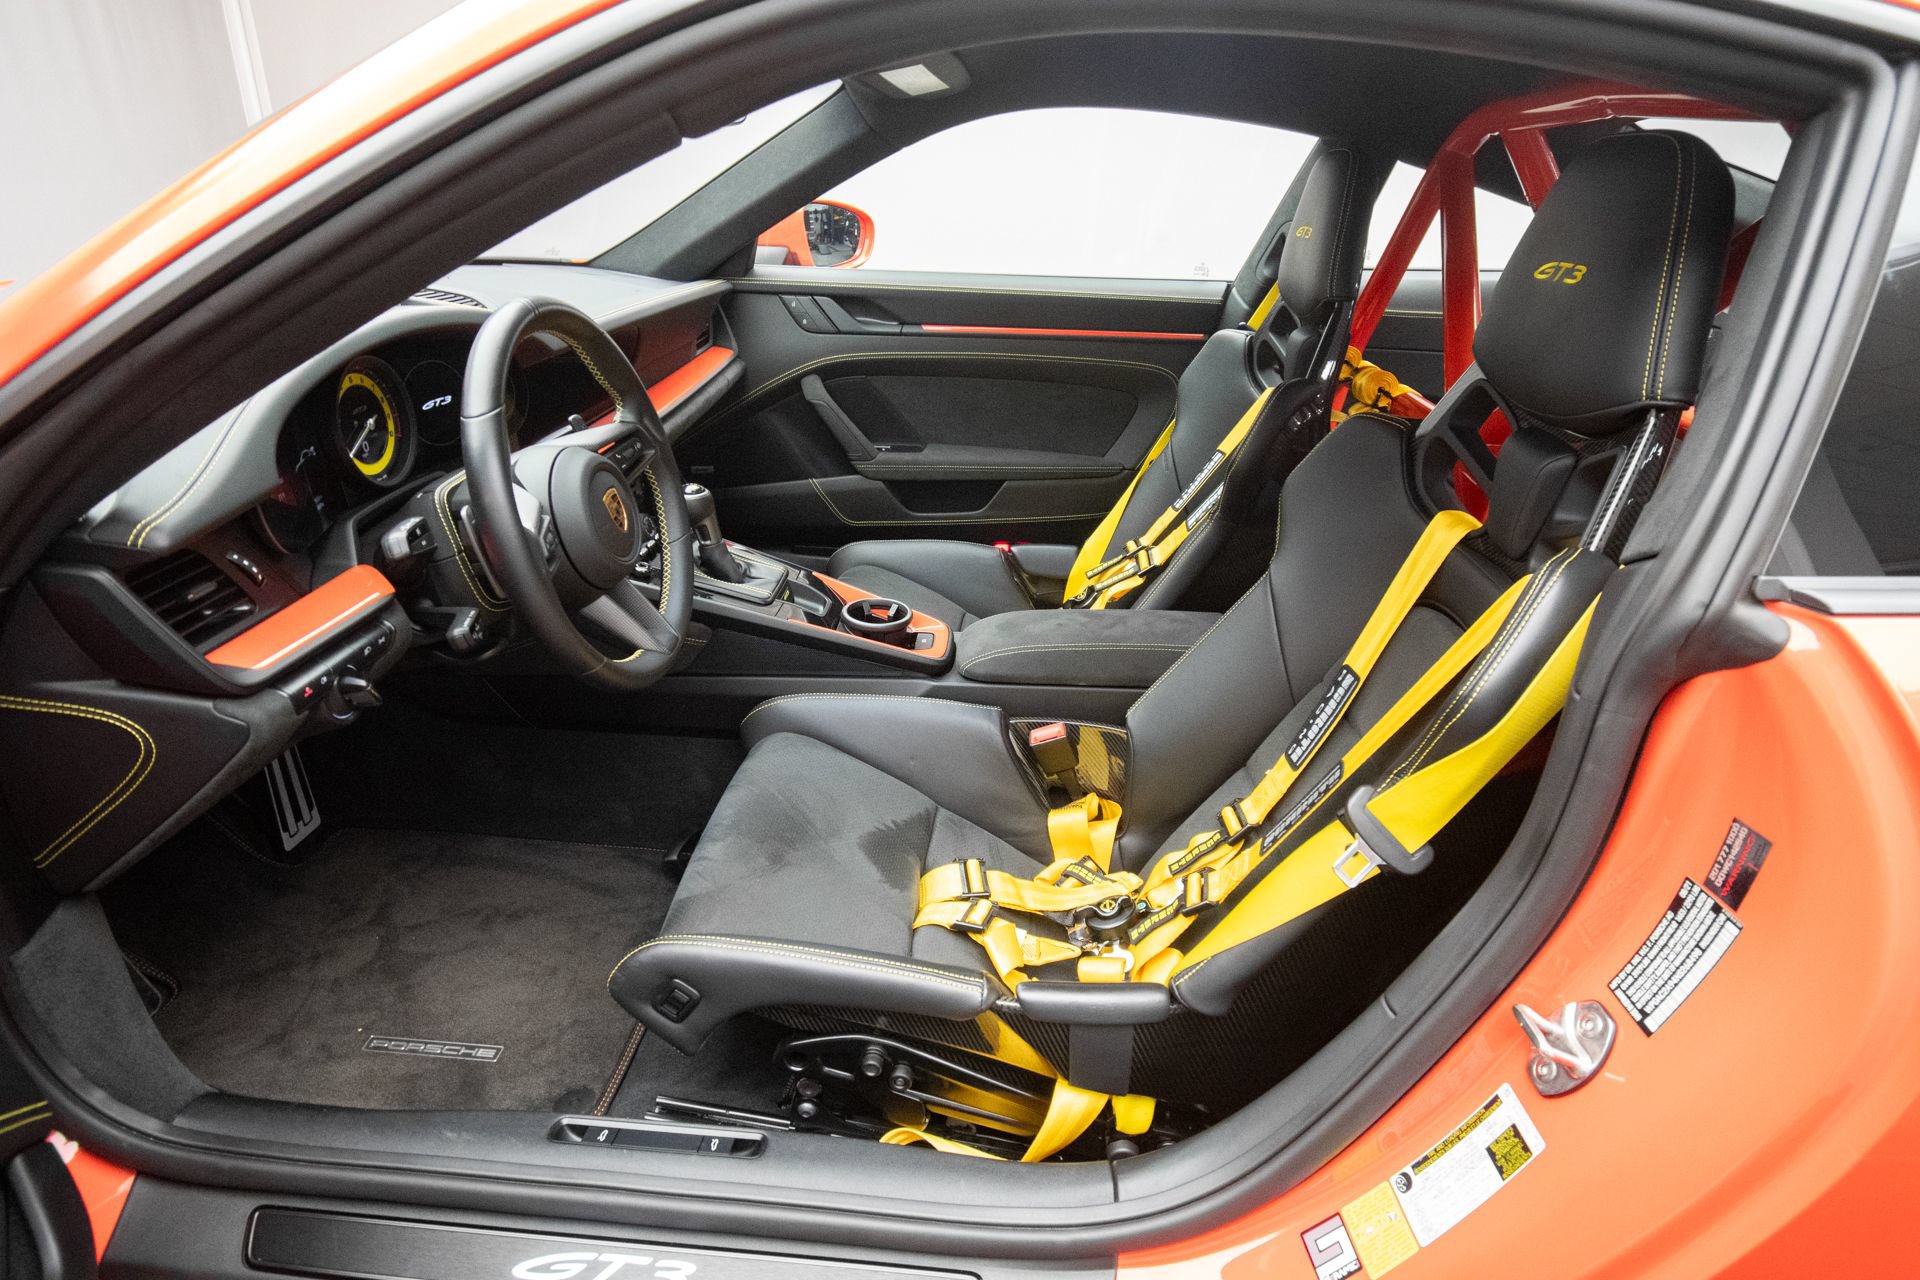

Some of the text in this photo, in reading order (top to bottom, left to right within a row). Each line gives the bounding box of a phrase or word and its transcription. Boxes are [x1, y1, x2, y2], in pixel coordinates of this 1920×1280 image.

[1296, 225, 1313, 239] GT3
[1533, 261, 1588, 285] GT3
[421, 395, 453, 412] GT3
[1289, 673, 1354, 762] SCHROTH
[1716, 844, 1729, 863] 777
[1719, 833, 1756, 896] WARNING
[368, 1039, 497, 1058] PORSCHE
[512, 1252, 697, 1280] GT3
